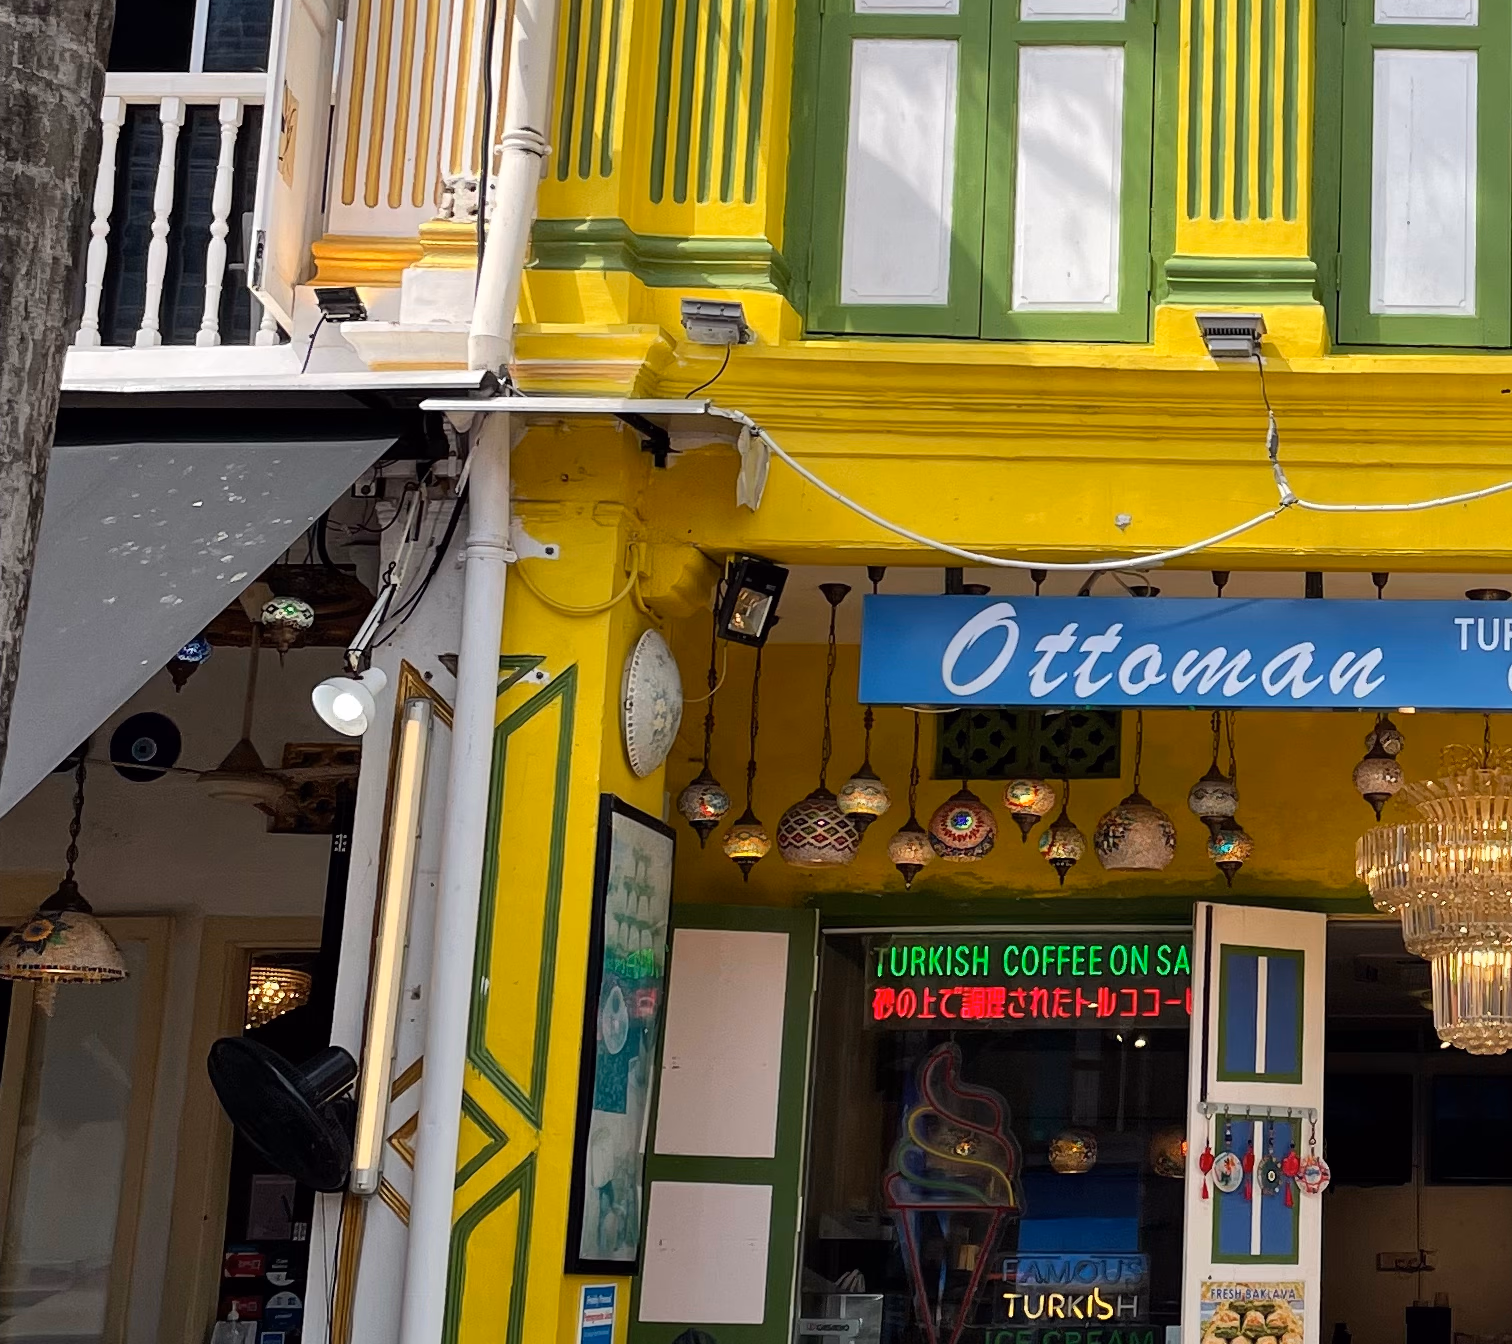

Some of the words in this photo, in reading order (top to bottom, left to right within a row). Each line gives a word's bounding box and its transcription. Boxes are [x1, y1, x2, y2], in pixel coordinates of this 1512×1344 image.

[940, 601, 1387, 699] Ottoman
[871, 944, 990, 977] TURKISH
[1003, 944, 1103, 976] COFFEE
[1110, 945, 1149, 976] ON
[1156, 944, 1192, 976] SA
[1003, 1258, 1143, 1286] FAMOUS
[1003, 1287, 1139, 1321] TURKISH
[1210, 1288, 1242, 1301] FRESH
[1245, 1288, 1296, 1300] BAKLAVA
